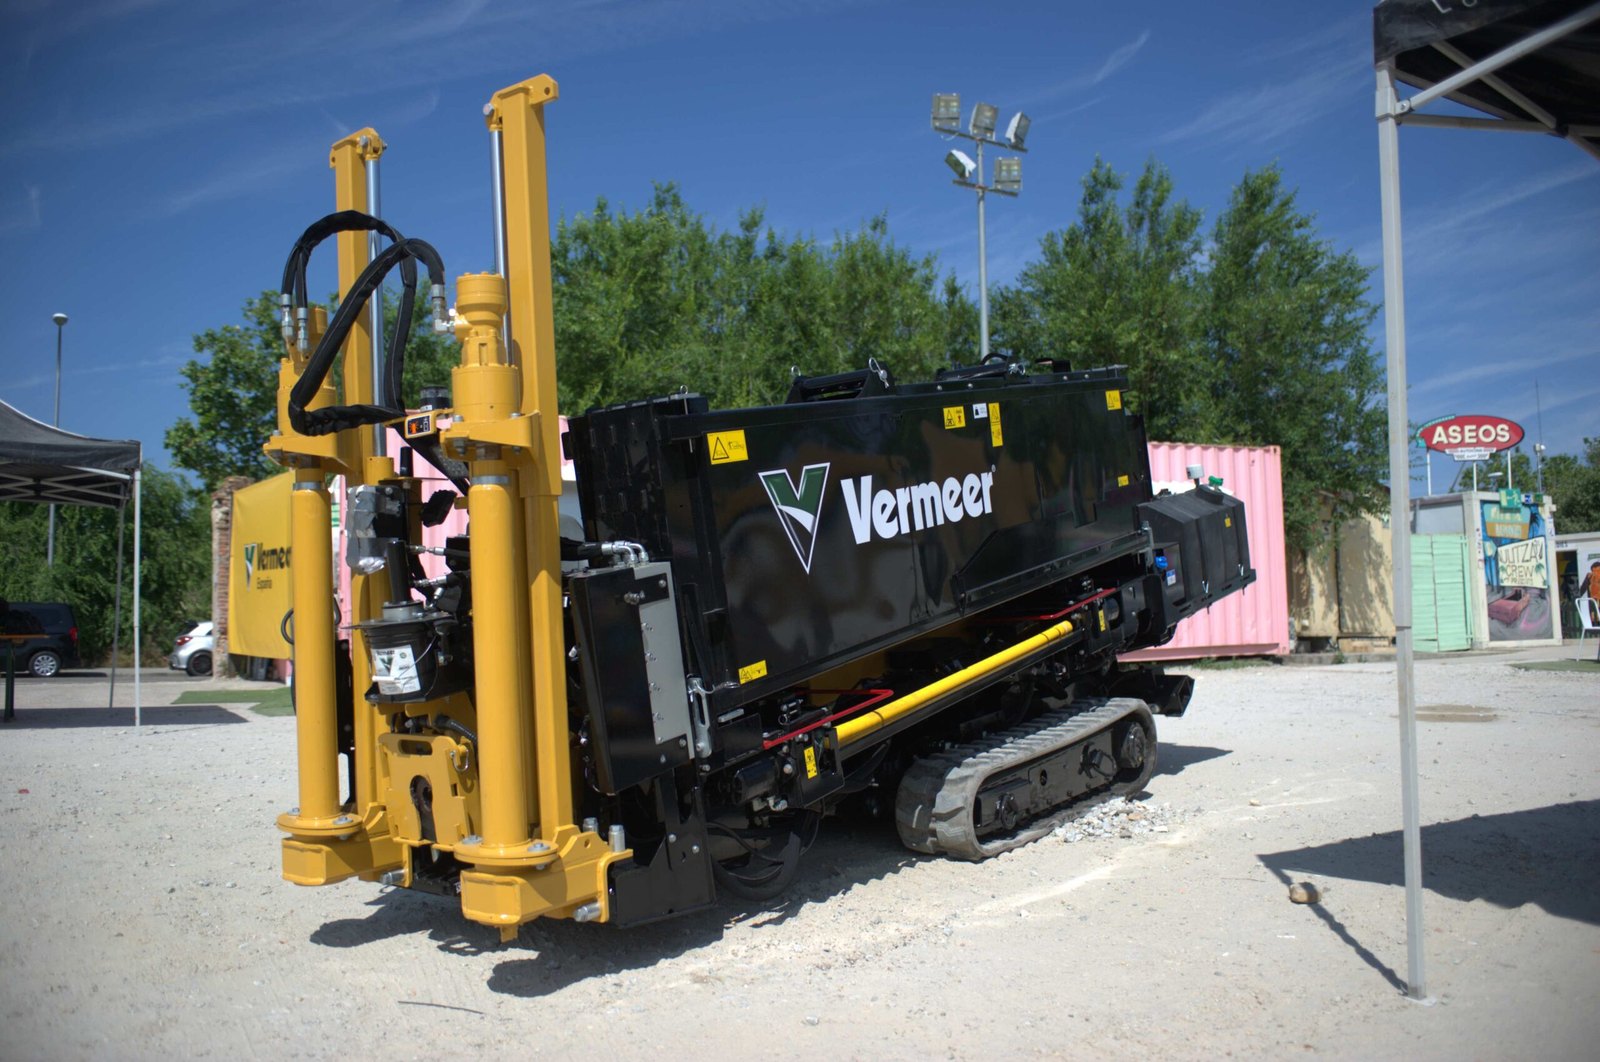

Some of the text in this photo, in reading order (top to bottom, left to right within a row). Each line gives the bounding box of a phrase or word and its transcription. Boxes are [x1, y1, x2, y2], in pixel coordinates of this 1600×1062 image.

[1432, 423, 1510, 444] ASEOS
[840, 471, 994, 545] Vermeer
[257, 542, 292, 571] Vermee
